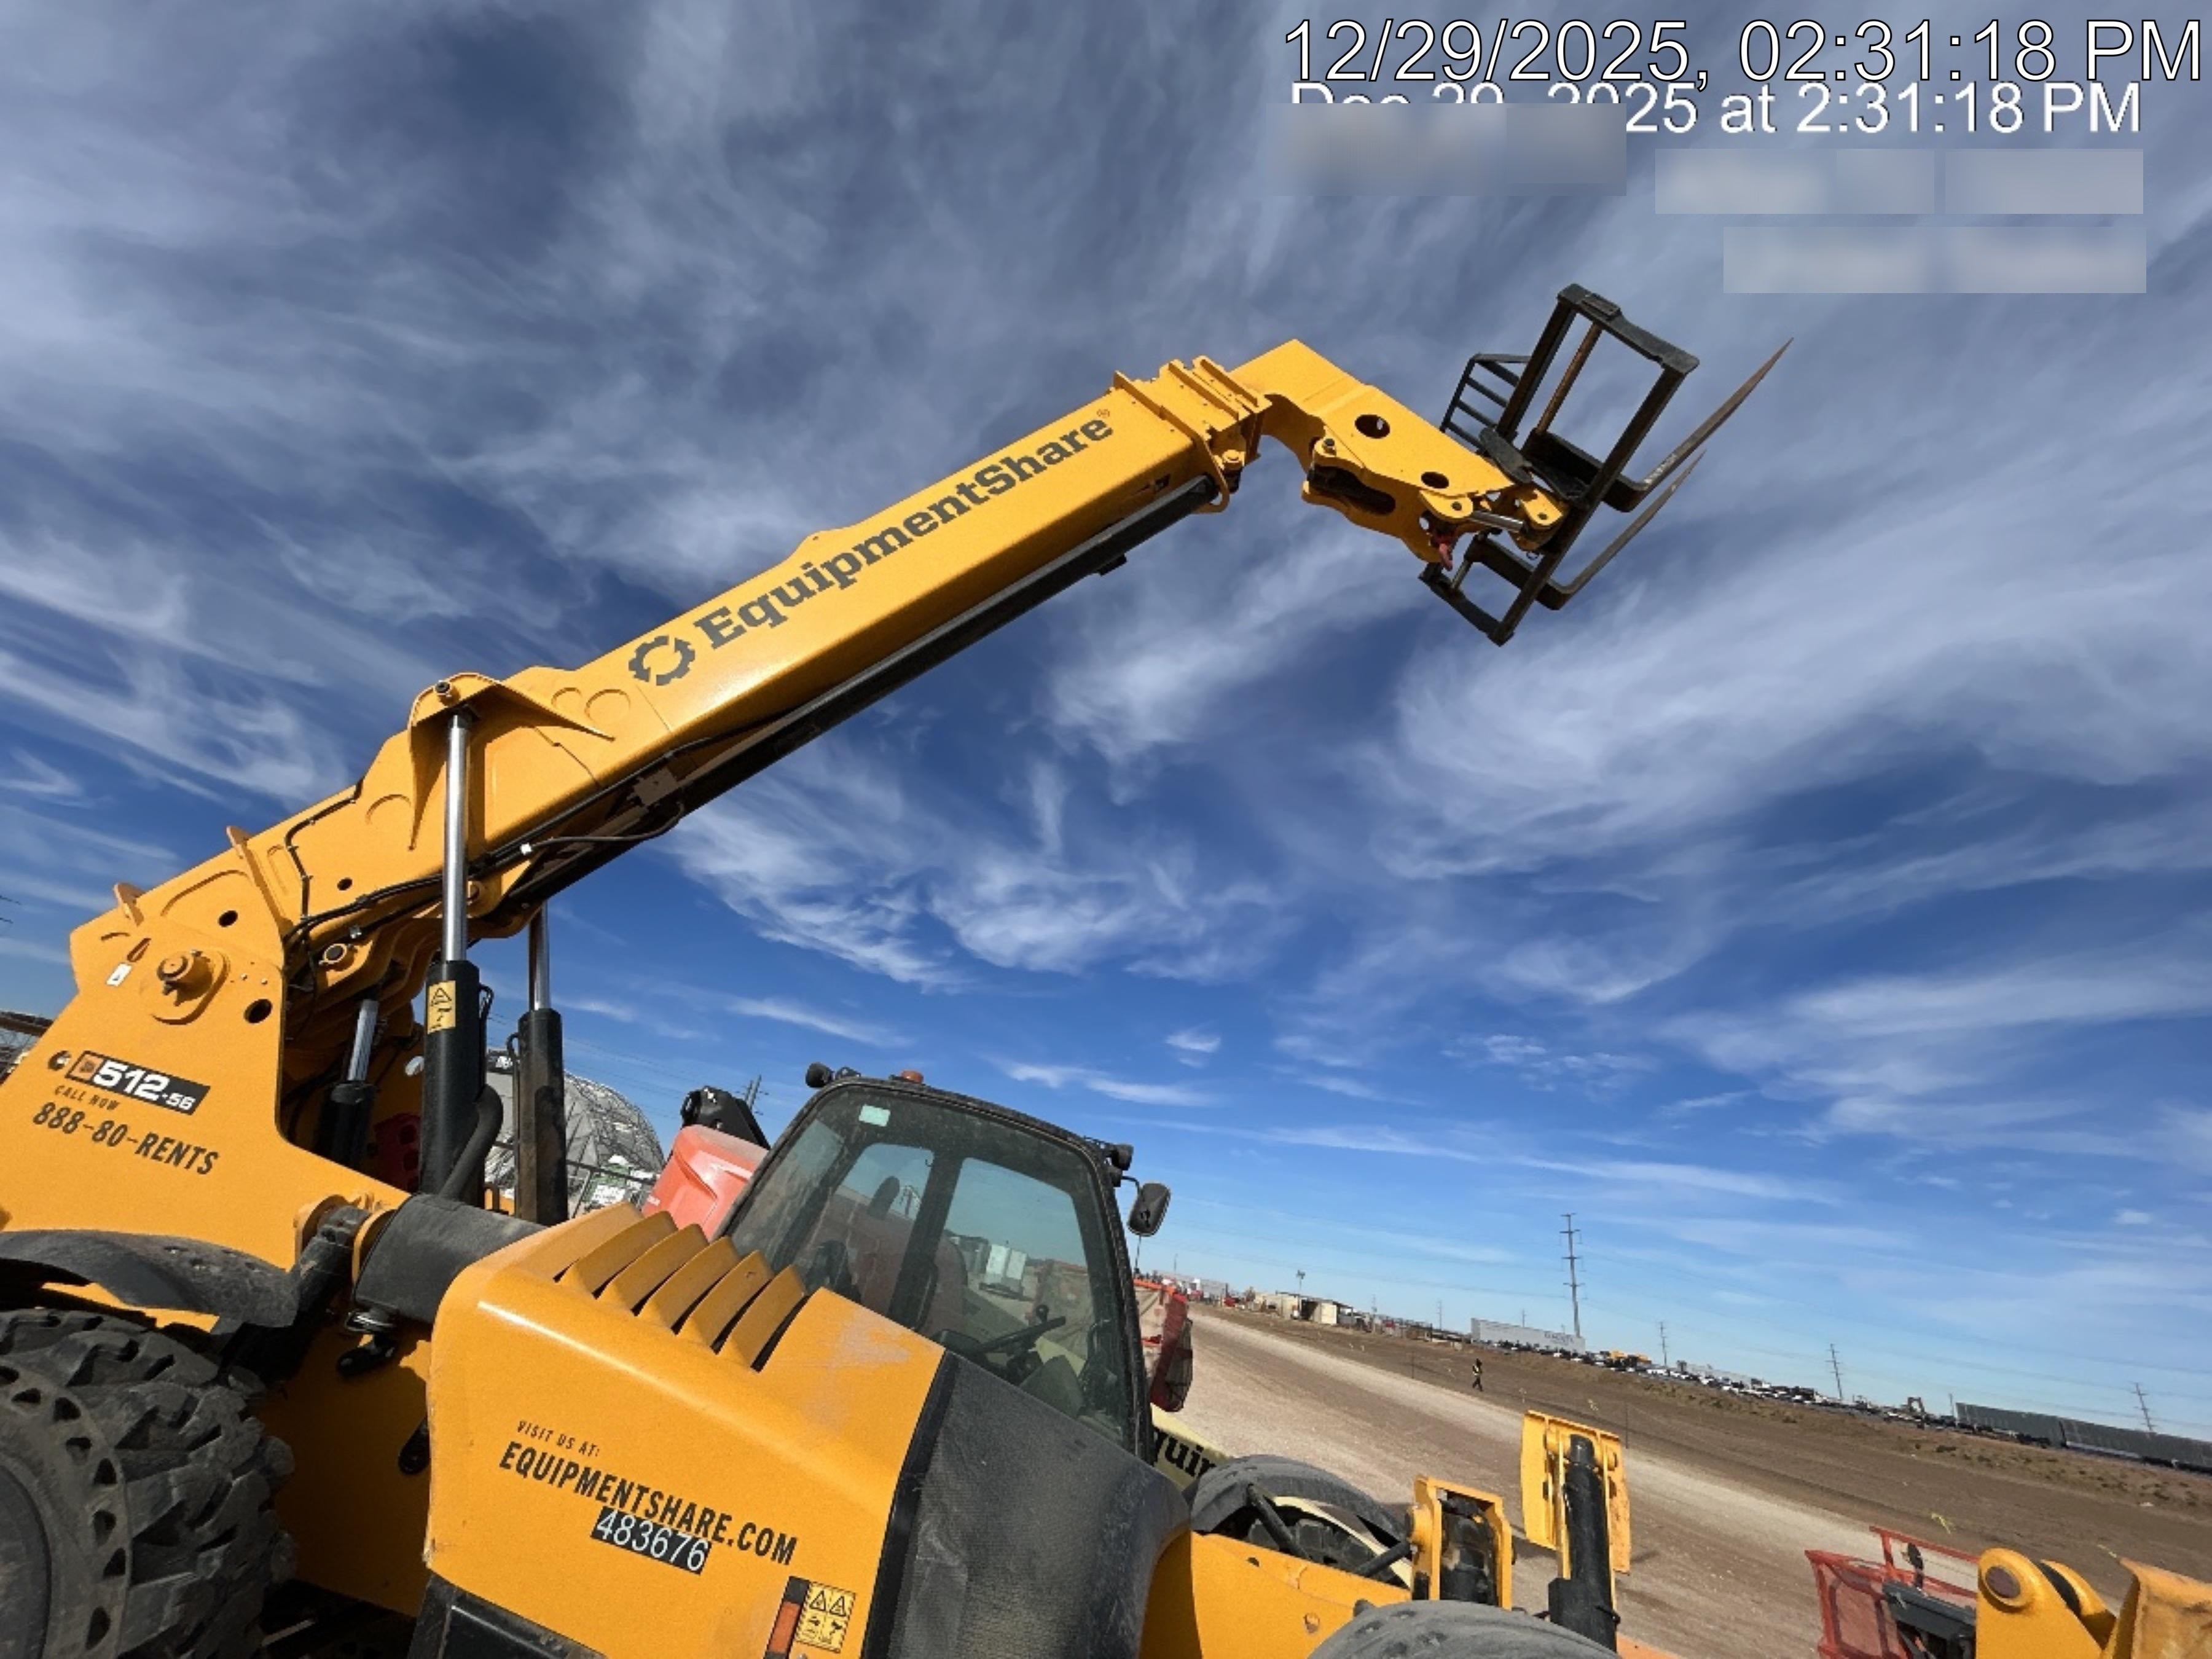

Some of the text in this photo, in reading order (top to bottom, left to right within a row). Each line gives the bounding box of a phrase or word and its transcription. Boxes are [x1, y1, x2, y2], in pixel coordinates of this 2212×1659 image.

[694, 419, 1113, 649] EquipmentShare
[54, 1085, 120, 1110] CALL NOW
[33, 1102, 219, 1174] 888-80-RENTS
[517, 1420, 600, 1457] VISIT US AT:
[499, 1441, 798, 1566] EQUIPMENTSHARE.COM
[595, 1509, 710, 1572] 483676
